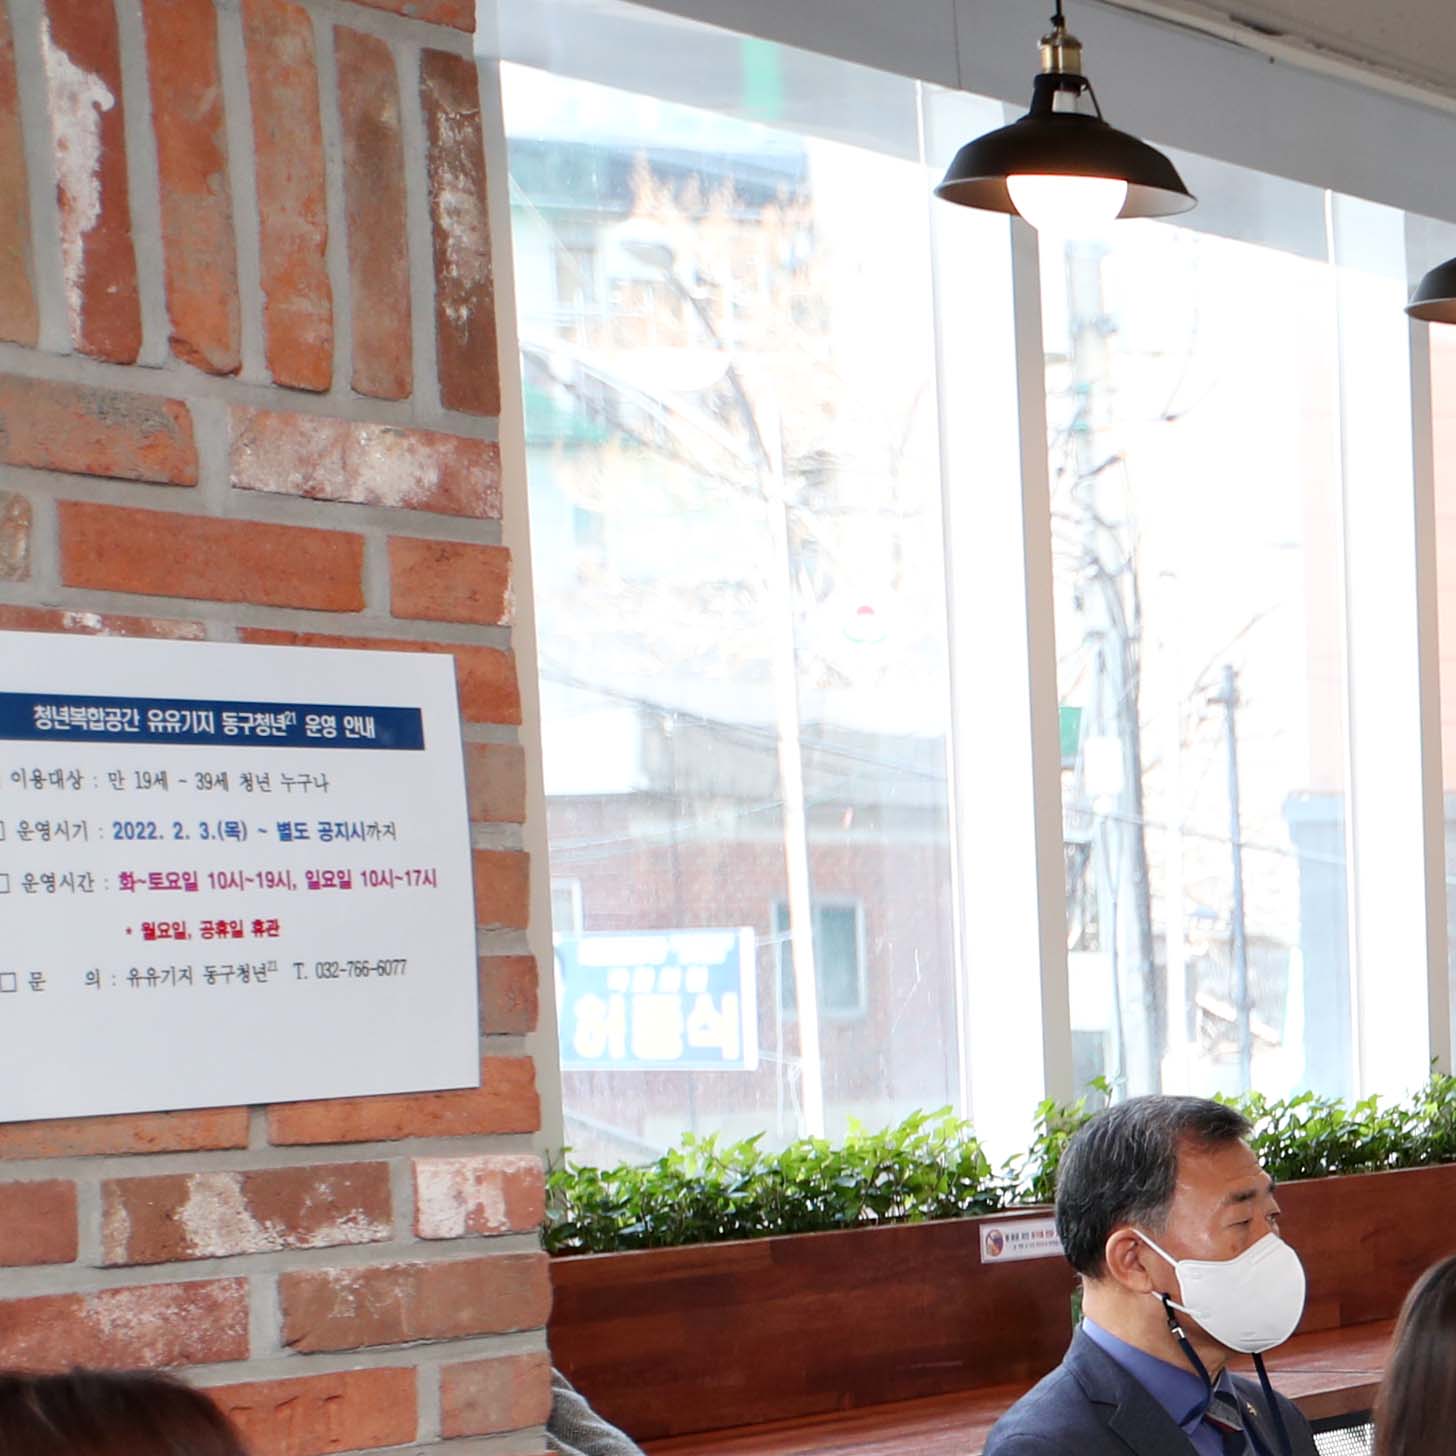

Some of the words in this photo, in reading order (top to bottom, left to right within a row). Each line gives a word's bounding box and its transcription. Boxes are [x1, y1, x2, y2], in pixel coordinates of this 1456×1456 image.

[33, 704, 140, 732] 청년복합공간
[147, 709, 215, 734] 유유기지
[304, 714, 338, 738] 운영
[343, 715, 376, 739] 안내
[10, 768, 84, 790] 이용대상
[108, 770, 125, 790] 만
[135, 770, 169, 791] 19세
[194, 771, 229, 792] 39세
[240, 772, 272, 793] 청년
[280, 772, 330, 793] 누구나
[16, 819, 88, 842] 운영시기
[112, 820, 164, 841] 2022.
[173, 821, 190, 841] 2.
[199, 820, 248, 842] 3.(목)
[276, 820, 310, 842] 별도
[317, 820, 397, 842] 공지시까지
[21, 871, 95, 894] 운영시간
[118, 870, 199, 893] 화~토요일
[207, 869, 297, 891] 10시~19시,
[305, 869, 352, 891] 일요일
[360, 868, 437, 889] 10시~17시
[141, 921, 192, 941] 월요일,
[199, 919, 244, 940] 공휴일
[251, 918, 281, 938] 휴관
[126, 965, 193, 988] 유유기지
